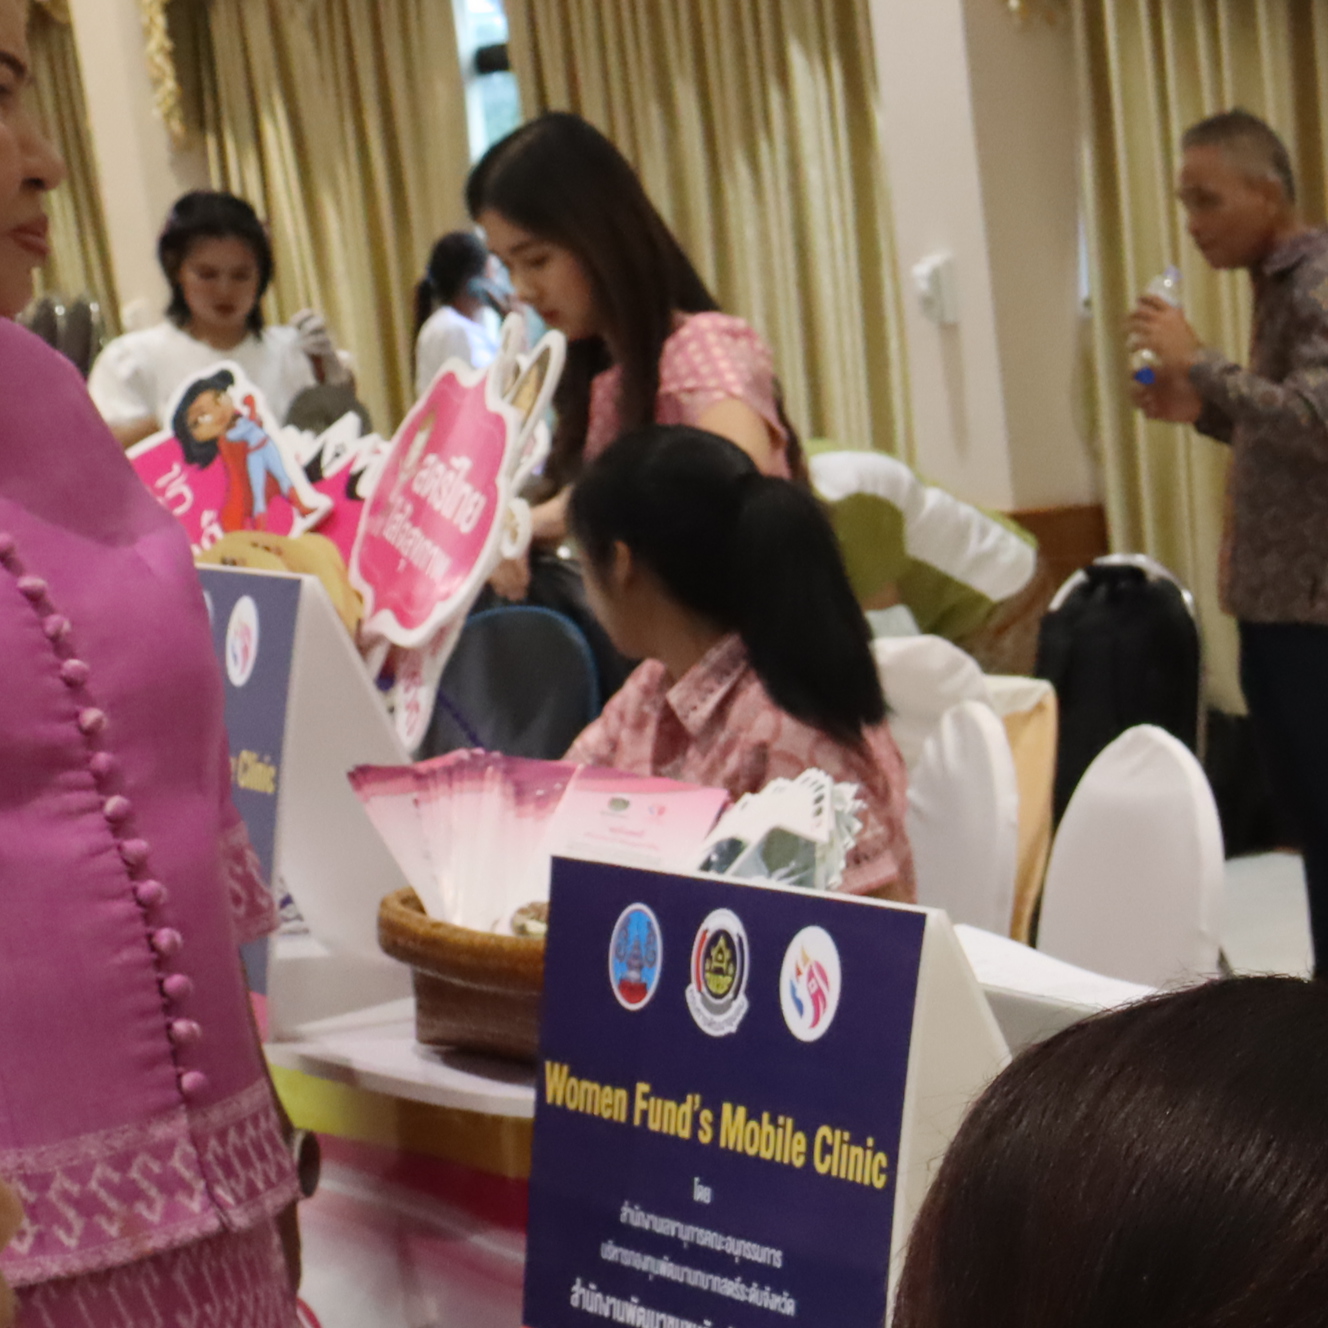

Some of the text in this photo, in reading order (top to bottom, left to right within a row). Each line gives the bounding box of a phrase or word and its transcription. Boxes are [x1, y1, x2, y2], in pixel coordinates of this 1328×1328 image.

[545, 1060, 888, 1190] Women Fund's Mobile Clinic
